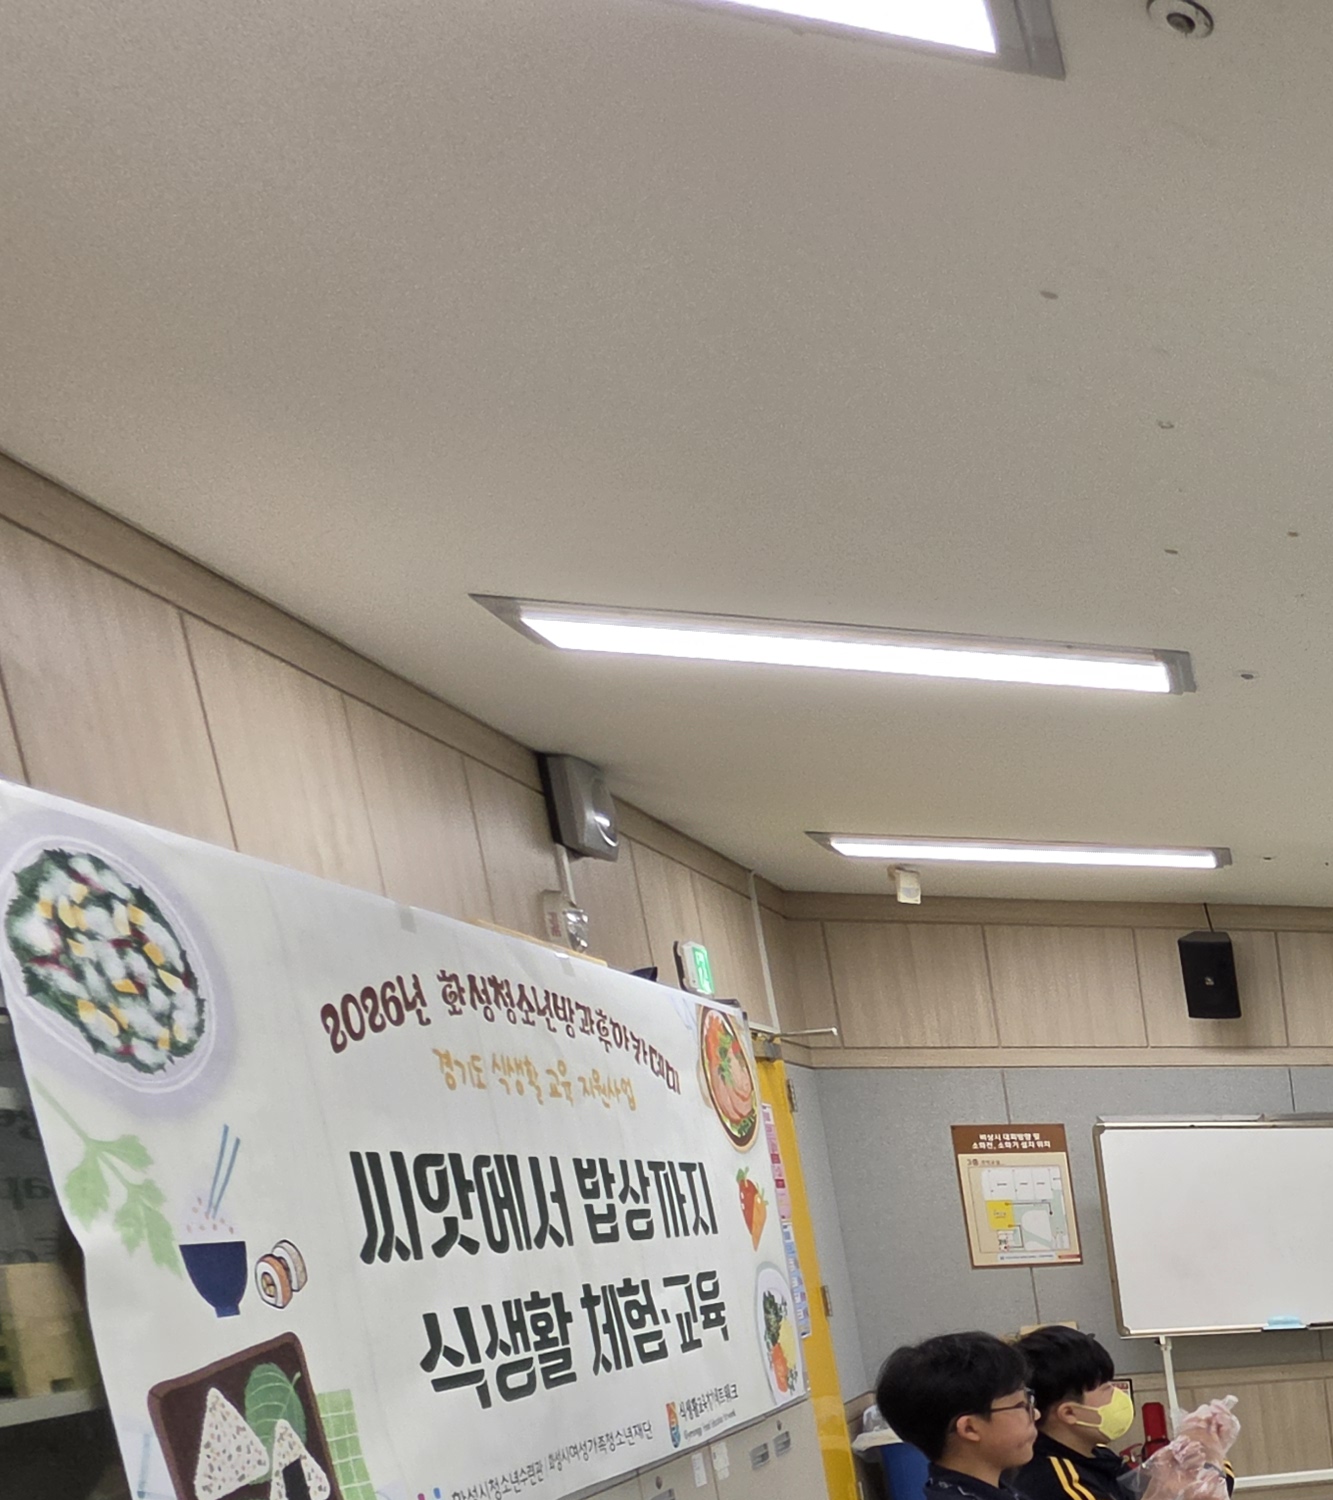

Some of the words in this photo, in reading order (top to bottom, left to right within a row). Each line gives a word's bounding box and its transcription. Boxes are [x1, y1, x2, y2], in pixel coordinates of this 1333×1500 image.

[320, 973, 431, 1053] 2026년
[437, 970, 682, 1094] 화성청소년방과후아카데미
[432, 1048, 487, 1091] 경기도
[491, 1053, 543, 1105] 식생활
[547, 1060, 573, 1106] 교육
[578, 1068, 636, 1111] 지원사업
[350, 1151, 574, 1264] 씨앗에서
[573, 1157, 718, 1244] 밥상까지
[420, 1291, 577, 1409] 식생활
[580, 1270, 730, 1375] 체험·교육
[548, 1420, 653, 1472] 화성시여성가족청소년재단
